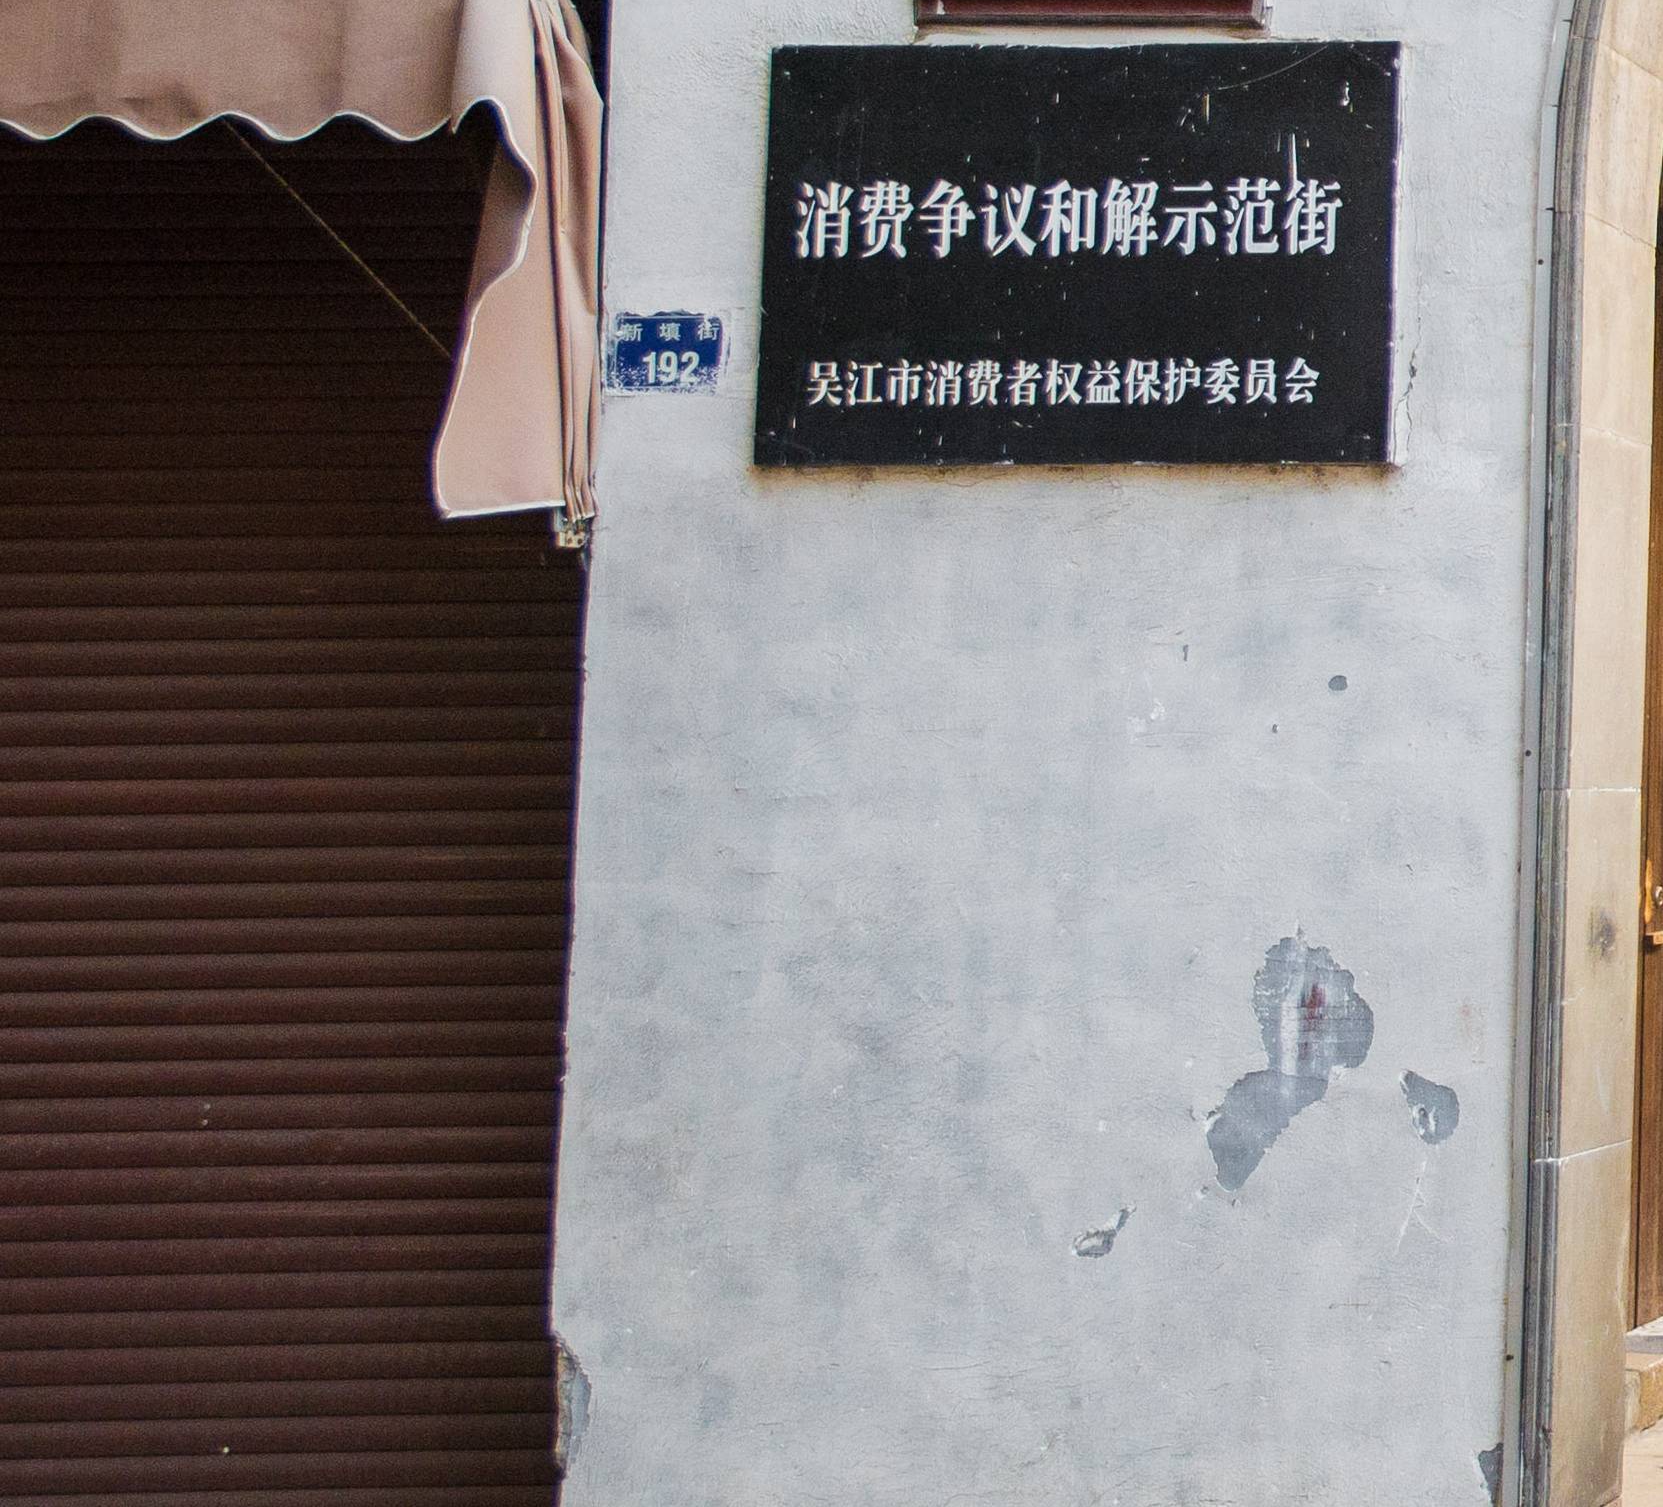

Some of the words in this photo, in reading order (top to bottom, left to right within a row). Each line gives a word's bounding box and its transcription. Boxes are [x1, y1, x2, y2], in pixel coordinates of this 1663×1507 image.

[794, 176, 1343, 259] 消费争议和解示范街
[642, 351, 700, 384] 192
[806, 356, 1321, 408] 吴江市消费者权益保护委员会
